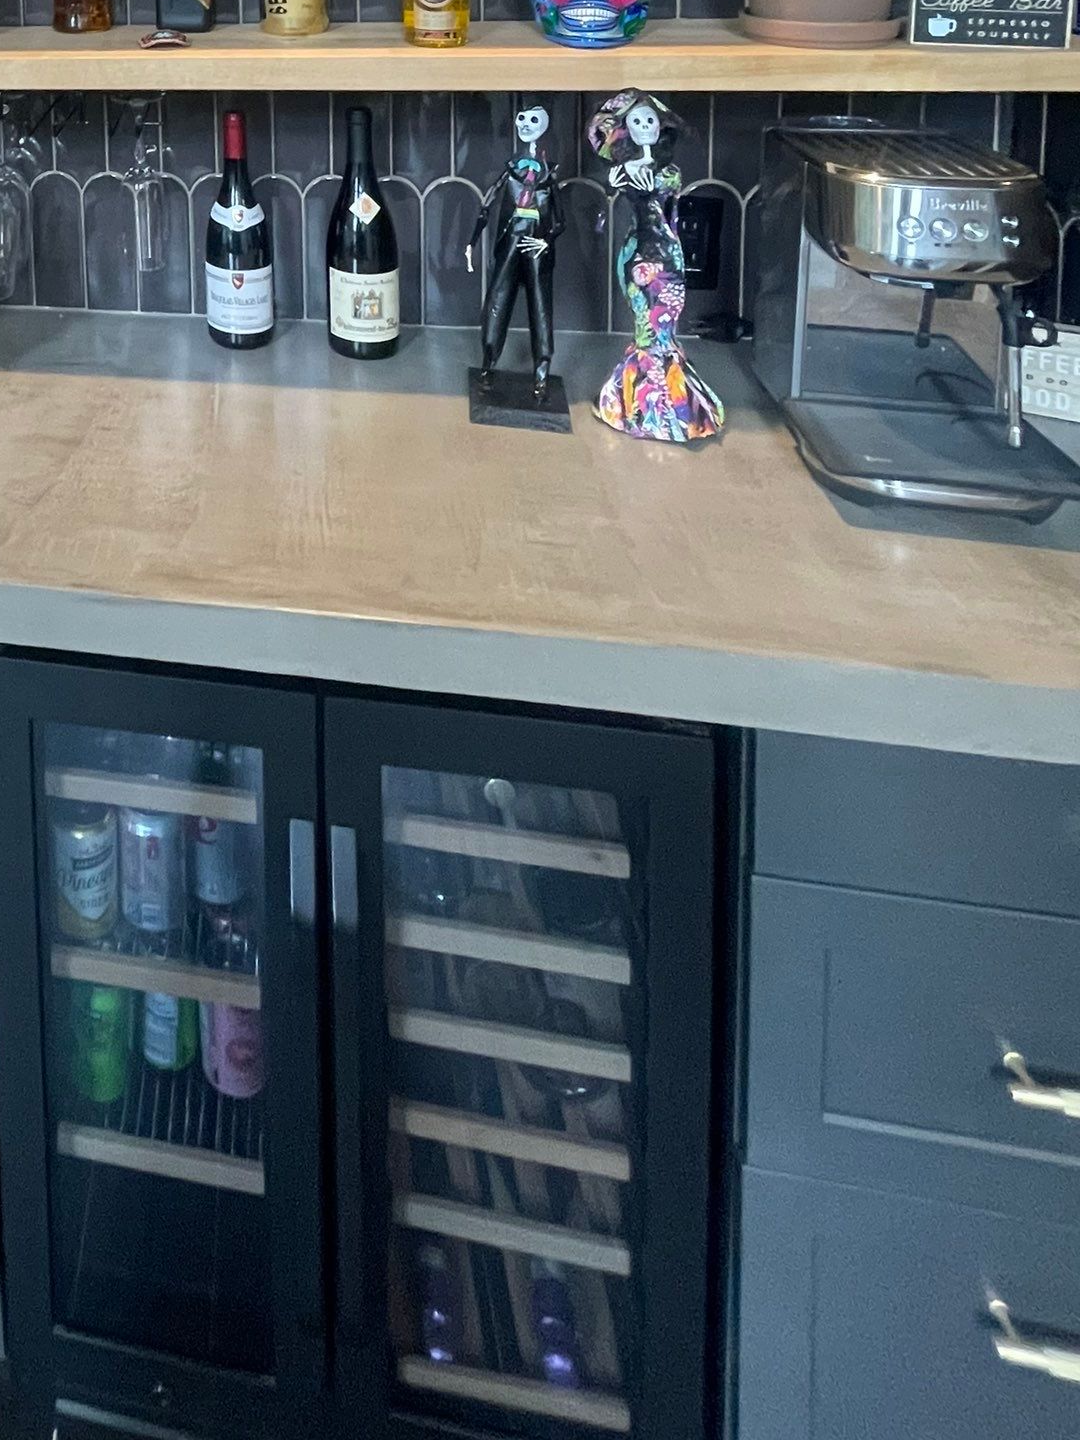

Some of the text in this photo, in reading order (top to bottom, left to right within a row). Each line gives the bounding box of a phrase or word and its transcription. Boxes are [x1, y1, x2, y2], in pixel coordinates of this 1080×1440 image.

[968, 18, 1051, 28] ESPRESSO
[967, 30, 1051, 41] YOURSELF
[1021, 385, 1071, 411] OOD
